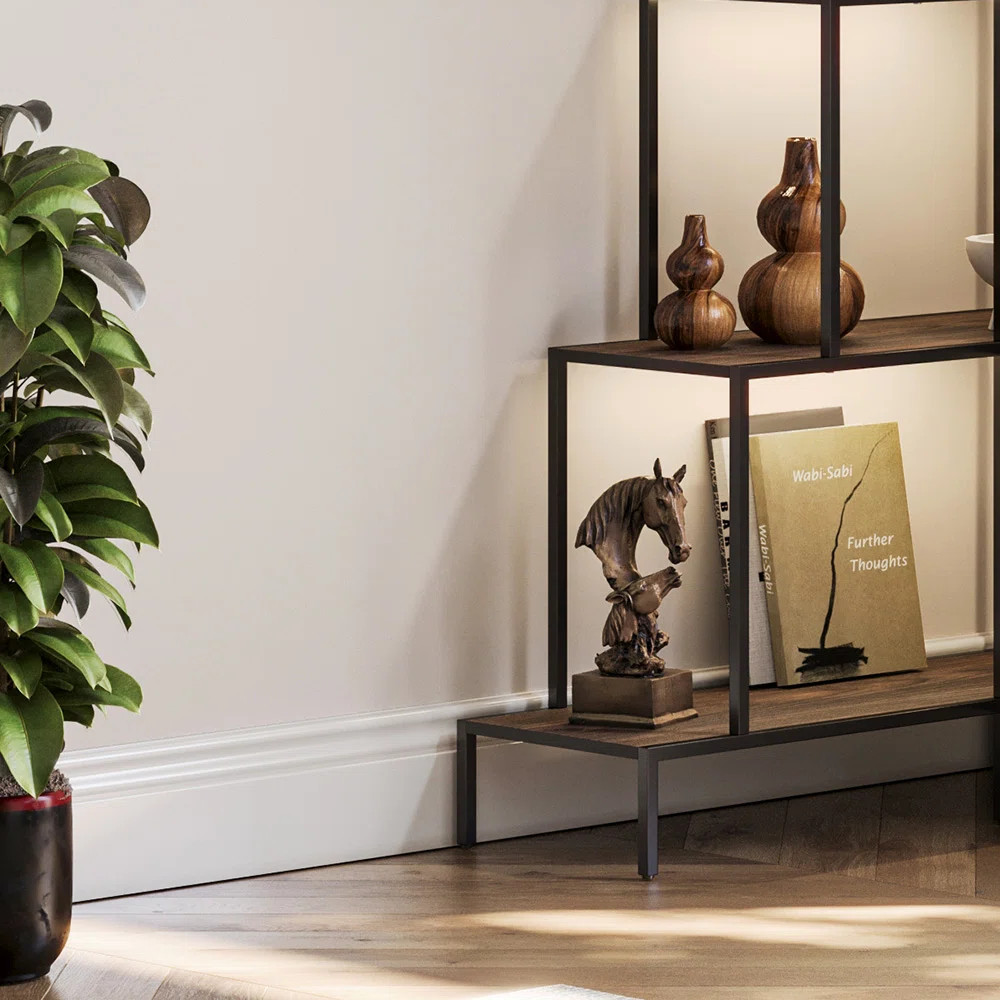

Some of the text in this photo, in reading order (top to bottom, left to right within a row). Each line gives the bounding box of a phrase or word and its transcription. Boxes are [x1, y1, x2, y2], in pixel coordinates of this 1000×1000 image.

[792, 464, 853, 483] Wabi-Sabi
[847, 534, 895, 549] Further
[759, 524, 774, 595] Wabi-Sabi
[850, 555, 908, 572] Thoughts
